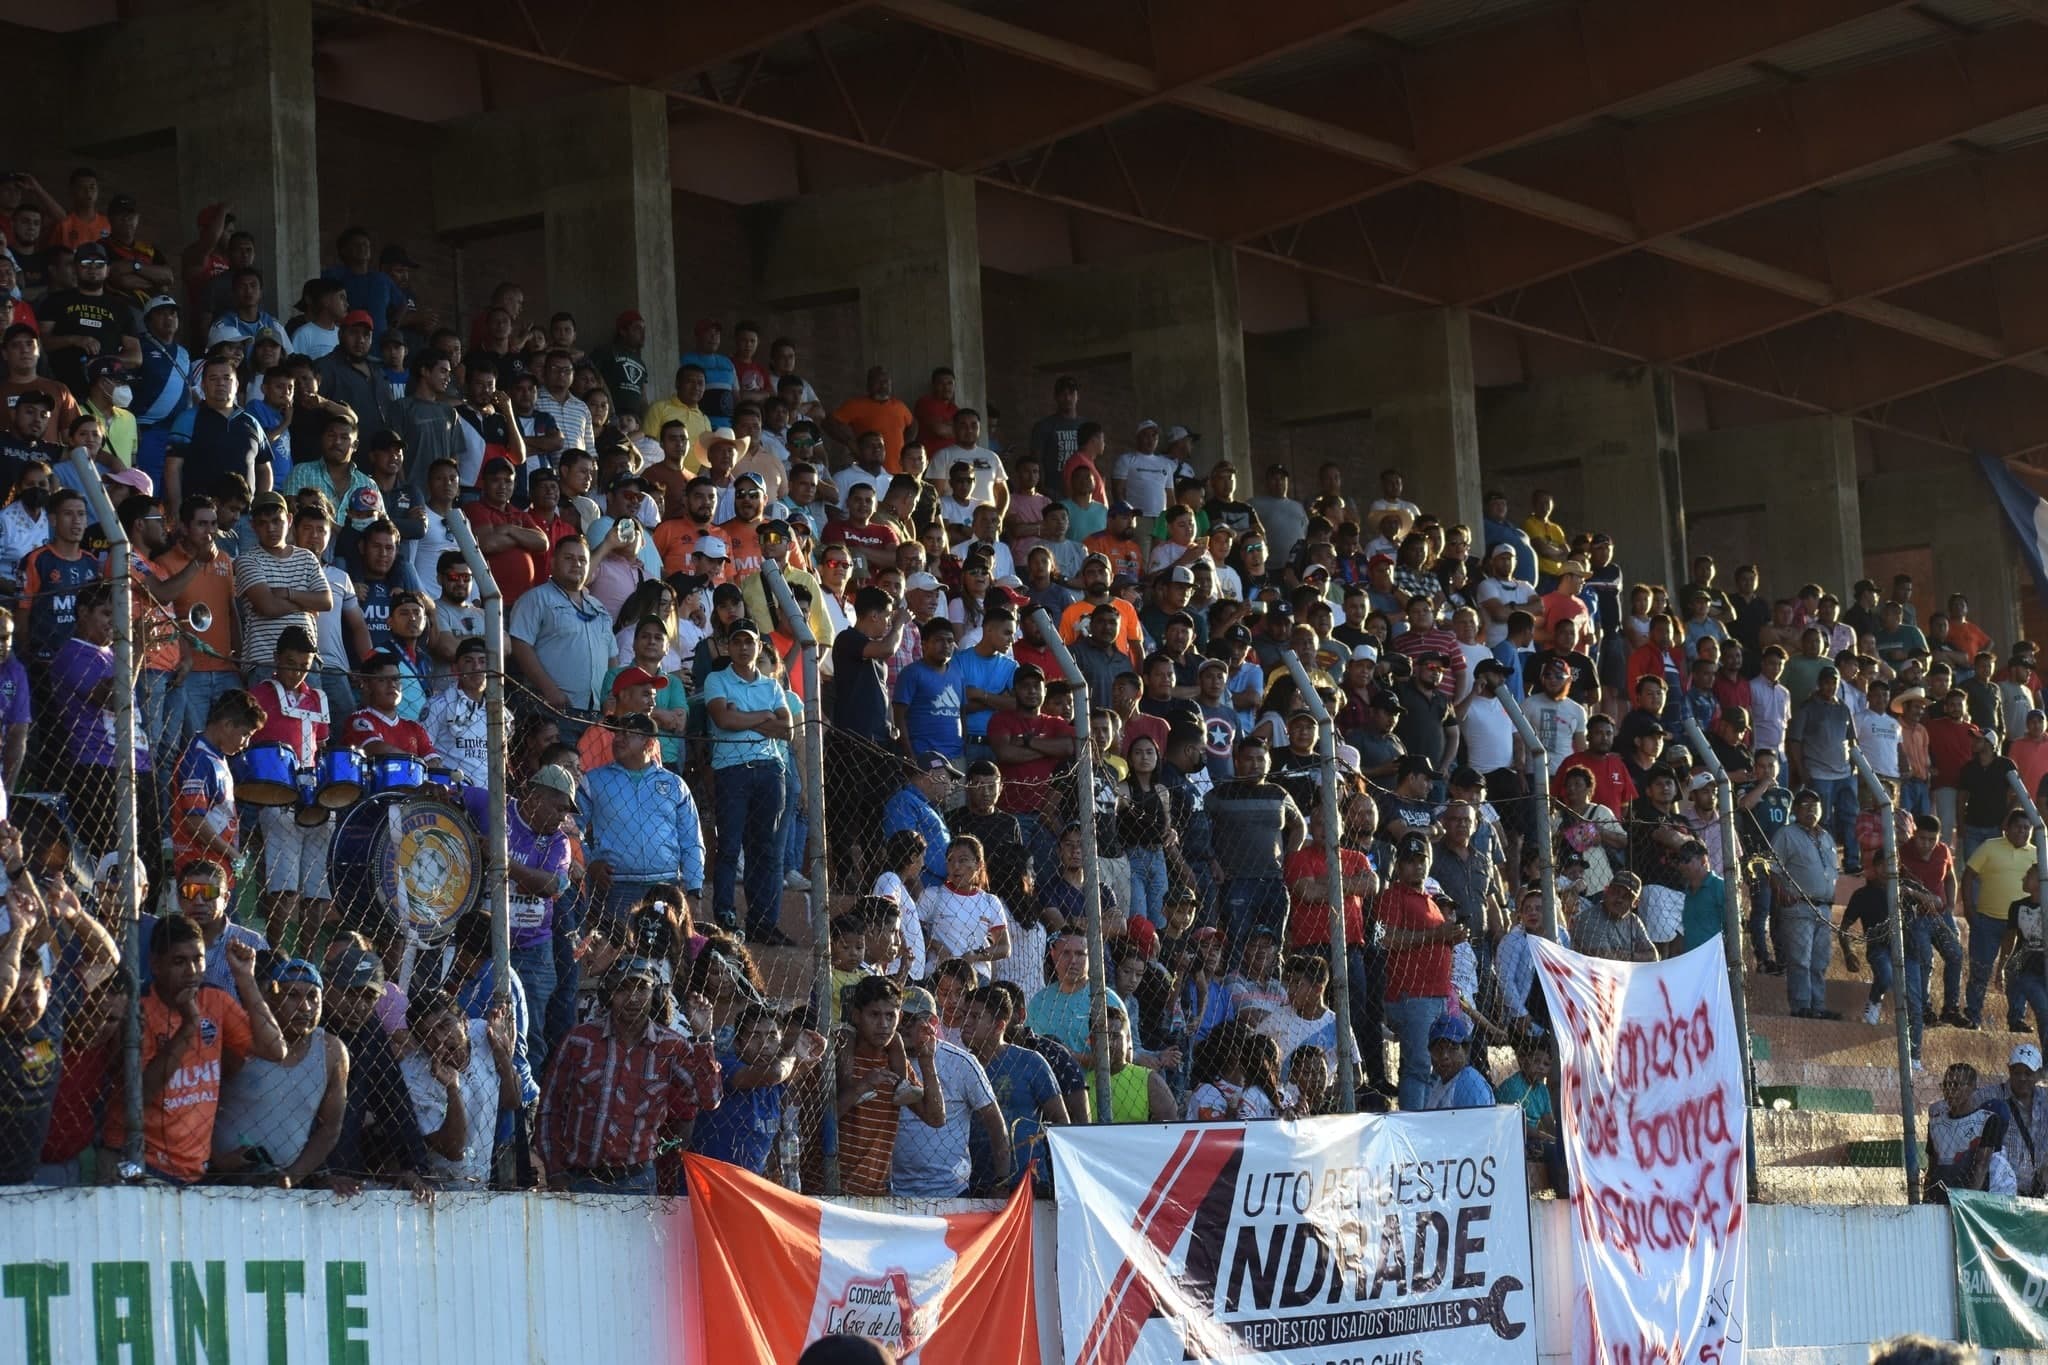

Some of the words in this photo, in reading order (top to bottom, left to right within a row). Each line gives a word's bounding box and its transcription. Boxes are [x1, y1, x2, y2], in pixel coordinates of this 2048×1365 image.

[66, 304, 114, 321] NAUTICA
[1769, 808, 1783, 823] 10
[848, 1285, 895, 1306] comedor
[867, 1312, 883, 1337] de
[1244, 1319, 1326, 1349] REPUESTOS
[1331, 1308, 1383, 1340] USADOS
[1388, 1302, 1462, 1334] ORIGINALES
